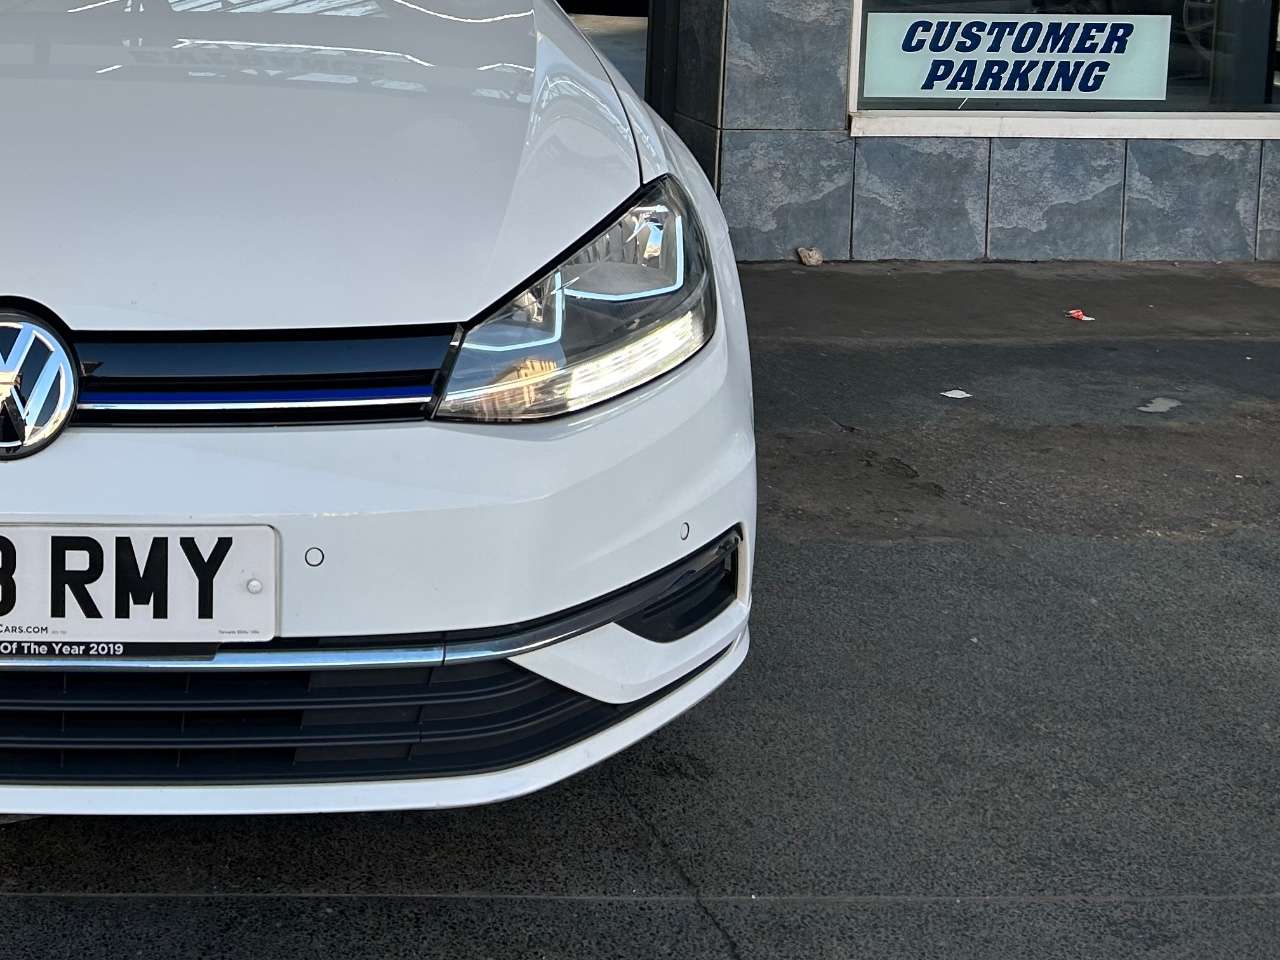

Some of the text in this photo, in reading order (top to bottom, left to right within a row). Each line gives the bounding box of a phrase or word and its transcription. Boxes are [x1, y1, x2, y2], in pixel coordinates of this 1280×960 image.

[901, 20, 1135, 54] CUSTOMER
[920, 59, 1111, 93] PARKING
[49, 535, 234, 620] RMY
[0, 642, 18, 654] Of
[21, 642, 48, 654] The
[51, 642, 85, 655] Year
[89, 643, 124, 655] 2019
